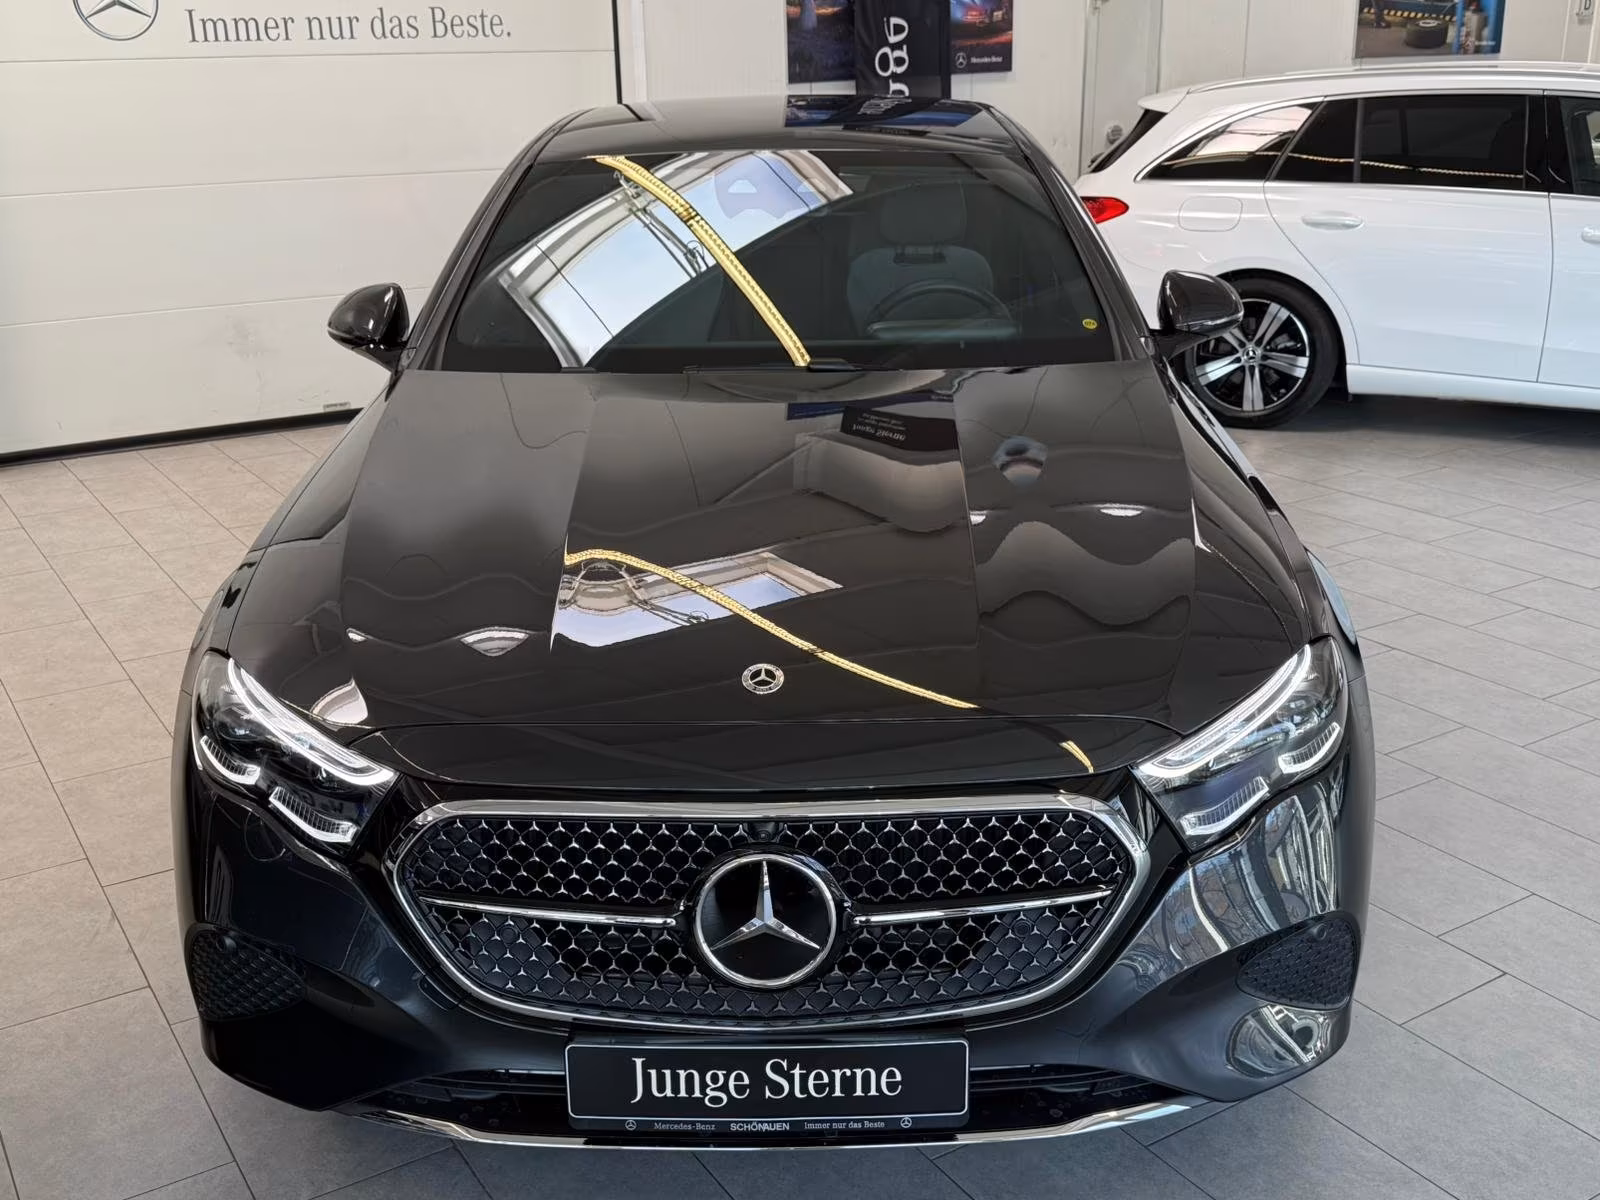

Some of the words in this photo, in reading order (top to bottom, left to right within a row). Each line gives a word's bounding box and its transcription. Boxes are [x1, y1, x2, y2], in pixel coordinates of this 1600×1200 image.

[184, 8, 295, 43] Immer
[305, 15, 360, 41] nur
[370, 6, 420, 40] das
[428, 6, 512, 39] Beste.
[630, 1057, 750, 1108] Junge
[764, 1058, 902, 1100] Sterne
[653, 1122, 716, 1130] Mercedes-Benz
[729, 1121, 790, 1132] SCHÖNAUEN
[804, 1121, 830, 1129] Immer
[848, 1120, 862, 1128] das
[864, 1120, 885, 1128] Beste
